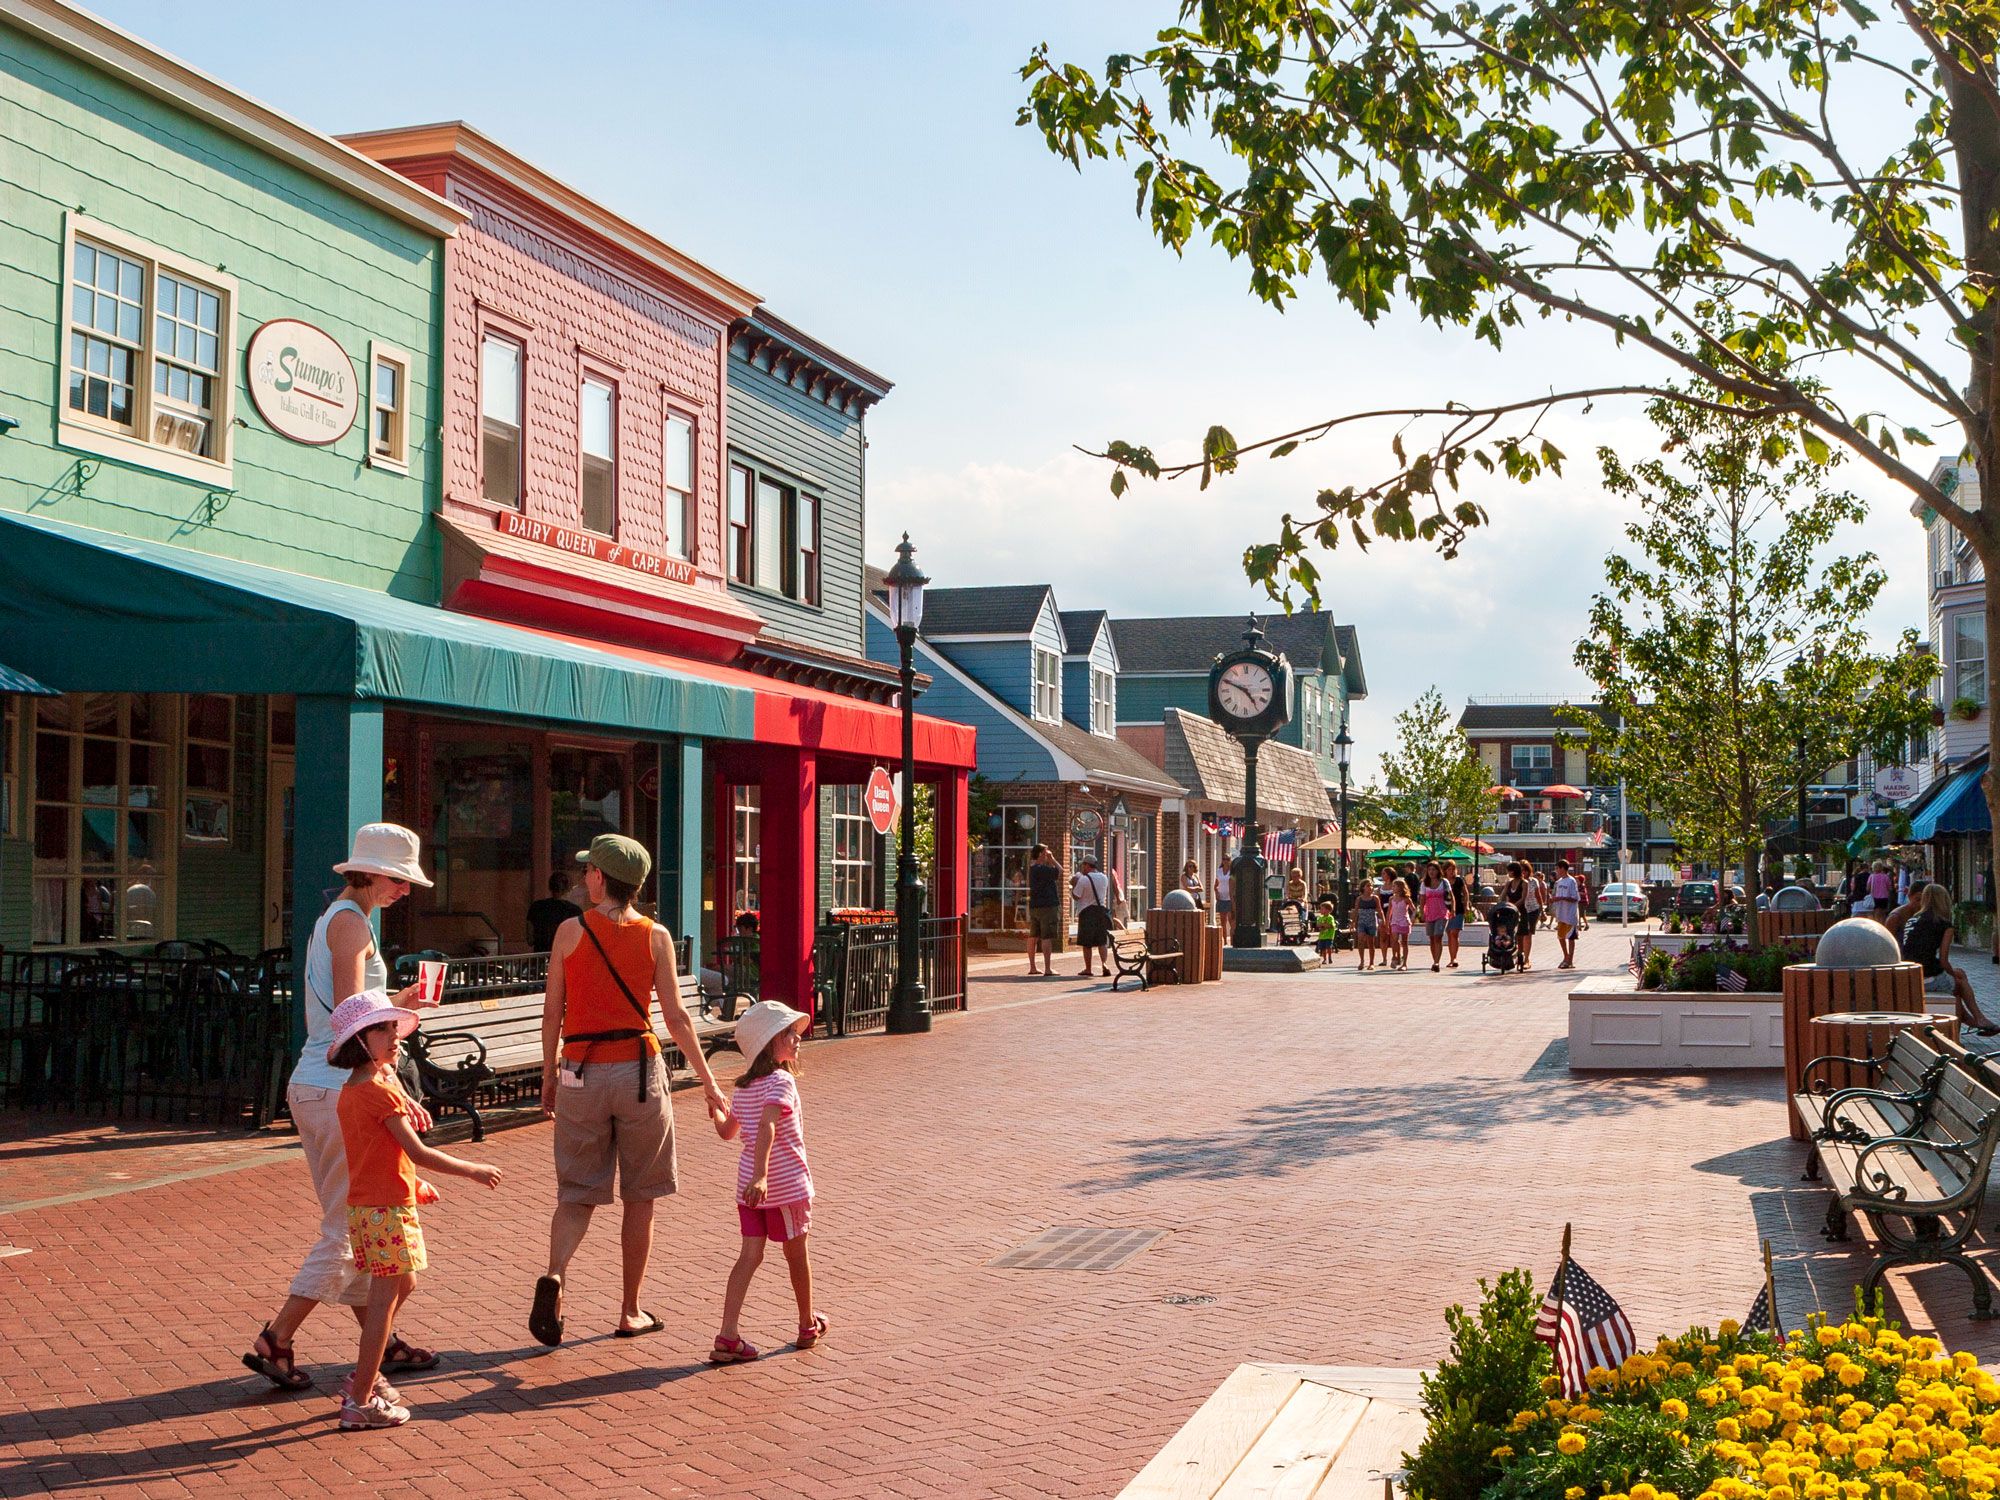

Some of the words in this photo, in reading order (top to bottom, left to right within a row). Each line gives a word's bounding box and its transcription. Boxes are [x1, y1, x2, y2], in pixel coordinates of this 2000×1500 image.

[274, 346, 345, 394] Stumpo's
[300, 402, 315, 421] Grill
[508, 515, 553, 542] DAIRY
[556, 529, 597, 557] QUEEN
[606, 545, 623, 563] of
[631, 551, 661, 574] CAPE
[664, 561, 692, 582] MAY
[873, 785, 890, 802] Dairy
[872, 799, 890, 814] Queen
